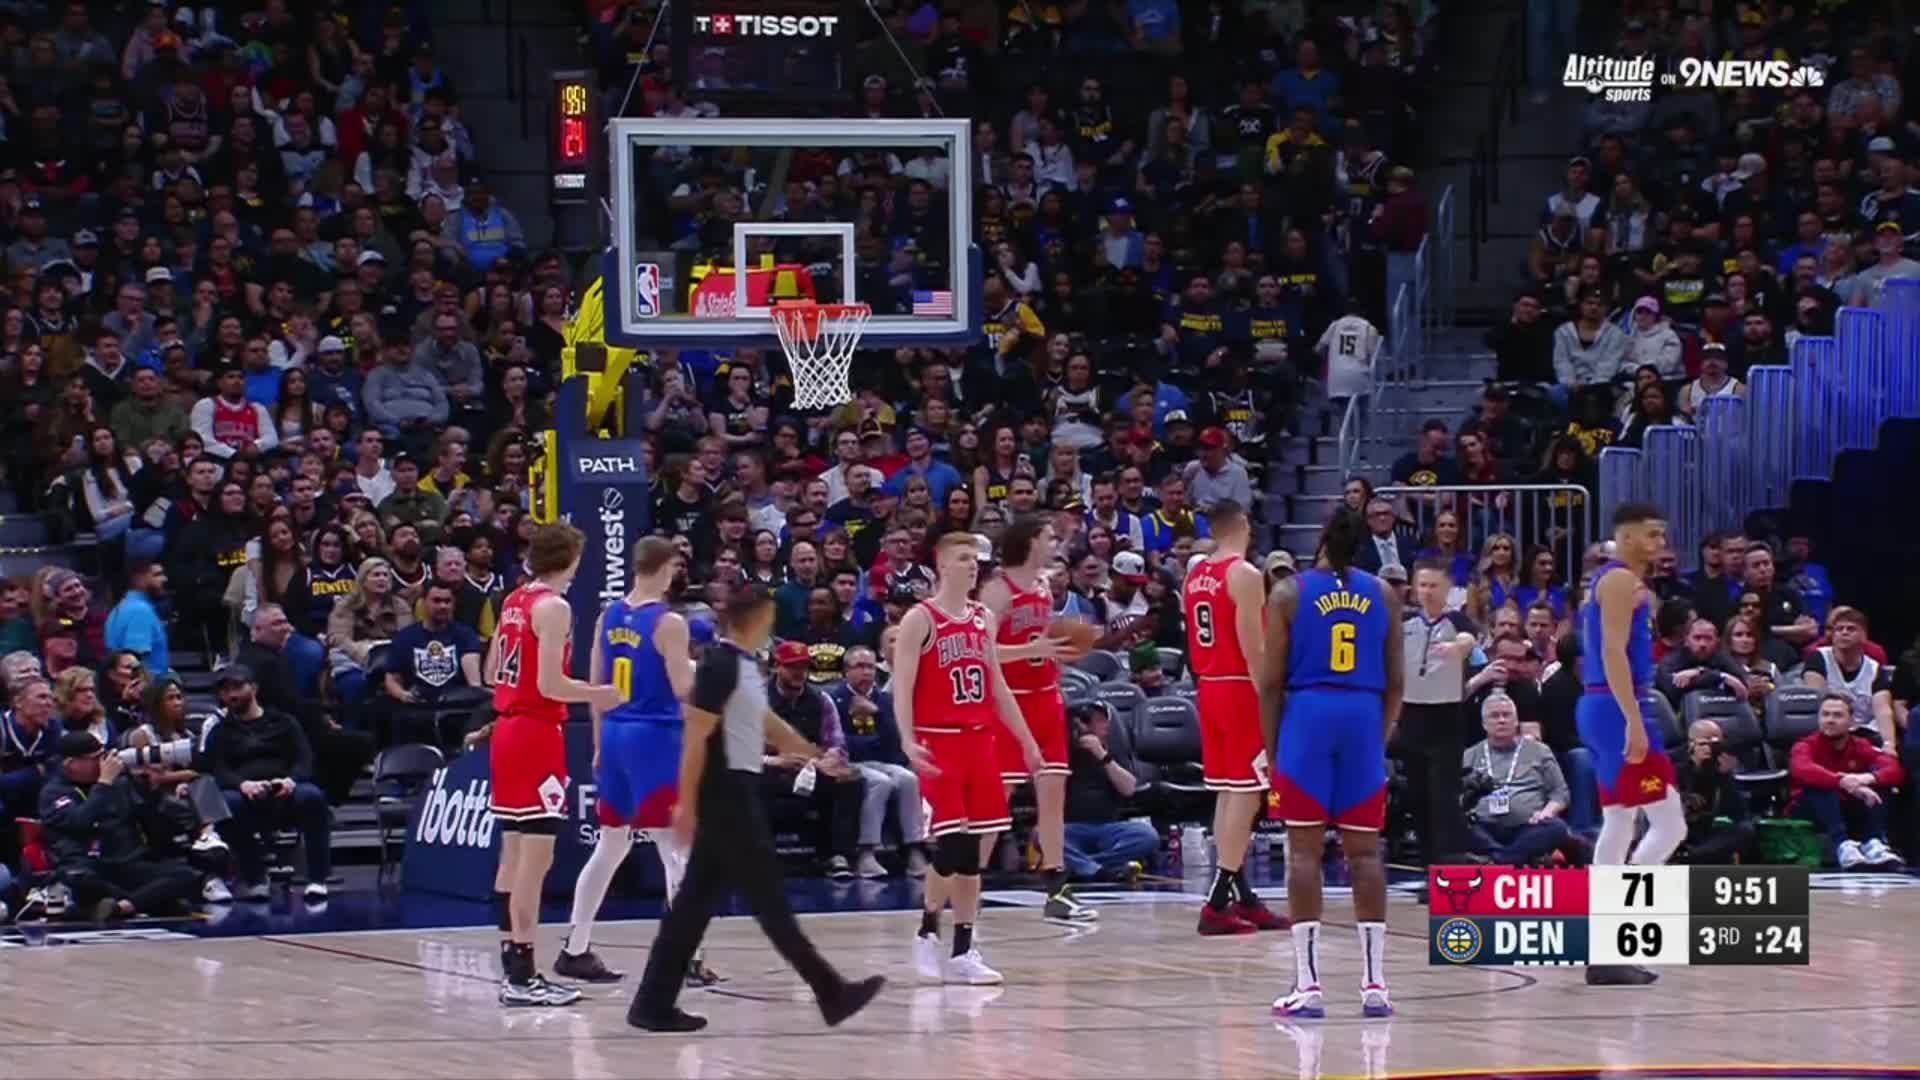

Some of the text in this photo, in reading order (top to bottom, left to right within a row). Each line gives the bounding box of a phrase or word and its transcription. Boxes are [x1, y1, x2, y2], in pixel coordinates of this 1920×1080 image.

[734, 15, 838, 37] TISSOT
[1339, 334, 1357, 355] 15
[578, 457, 635, 473] PATH
[1194, 600, 1215, 648] 9
[1314, 591, 1371, 616] JORDAN
[494, 633, 522, 689] 14
[1330, 621, 1356, 673] 6
[613, 656, 632, 702] 0
[949, 664, 984, 704] 13
[416, 767, 497, 848] ibotta
